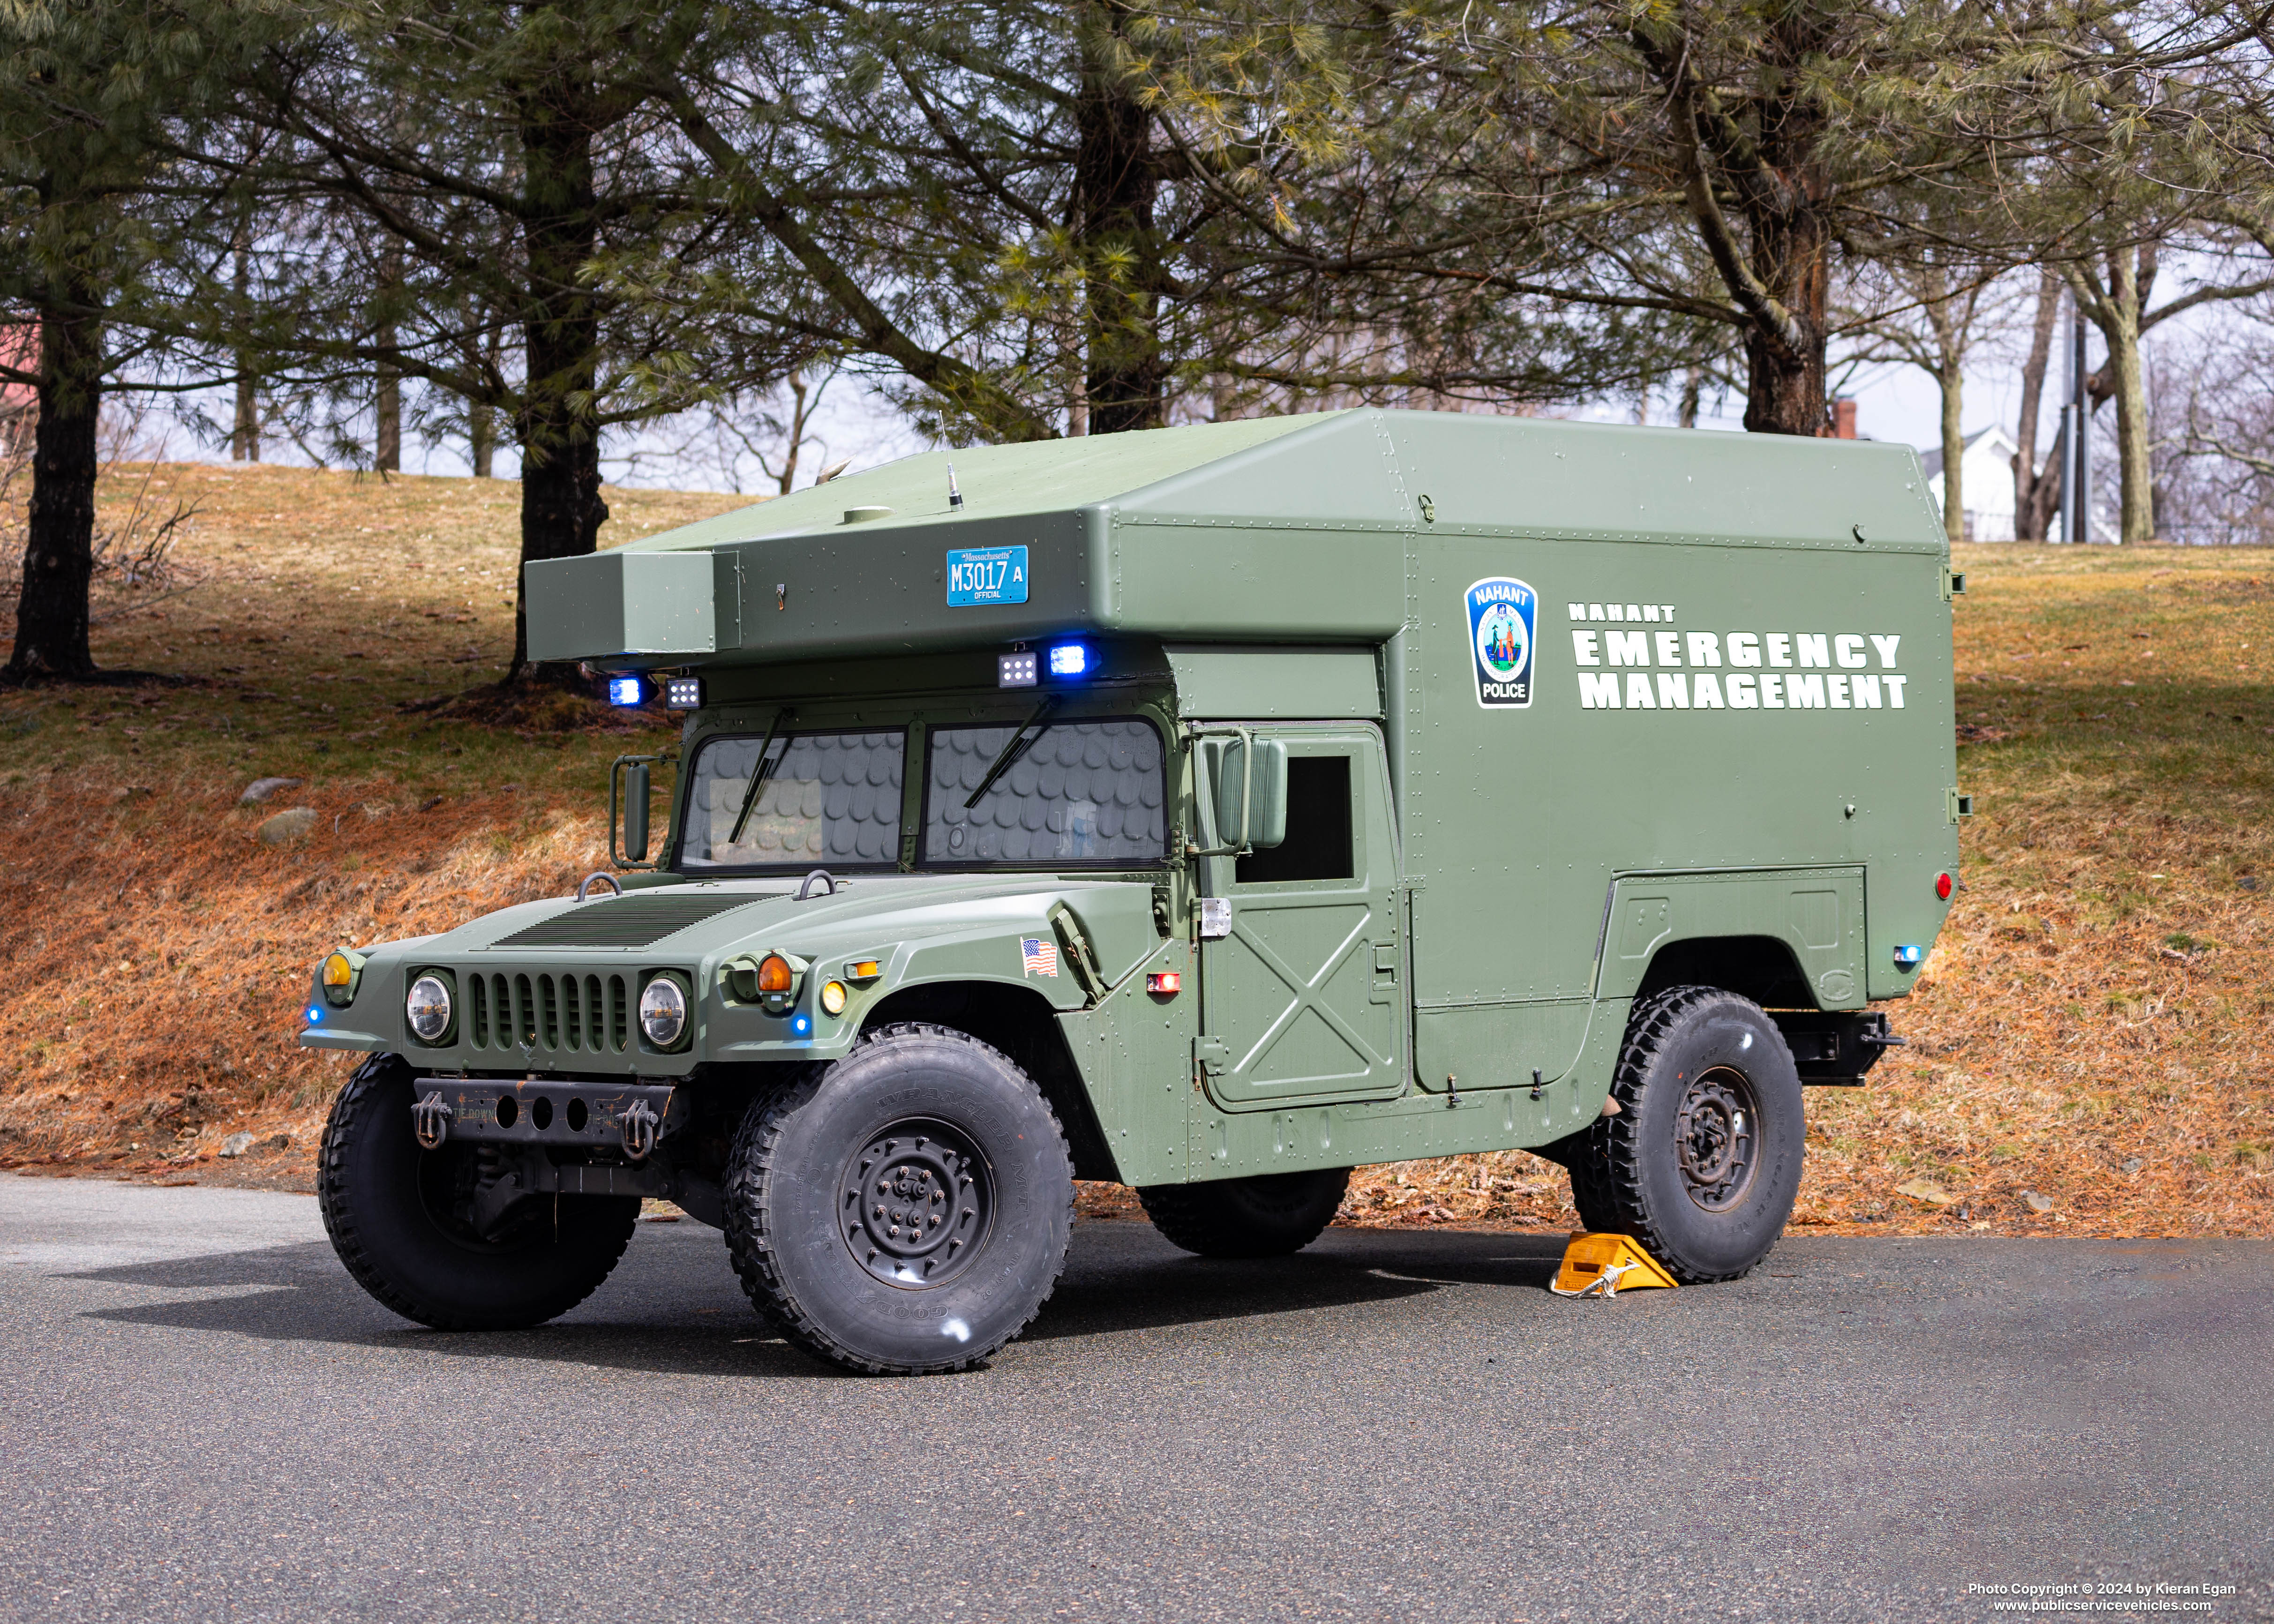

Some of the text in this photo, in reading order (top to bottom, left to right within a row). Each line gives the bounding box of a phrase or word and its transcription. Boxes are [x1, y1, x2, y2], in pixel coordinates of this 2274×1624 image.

[965, 552, 1009, 561] Massachusetts
[952, 561, 1023, 592] M3017 A
[975, 591, 1001, 599] OFFICIAL
[1475, 585, 1529, 606] NAHANT
[1568, 602, 1675, 622] NAHANT
[1571, 629, 1901, 669] EMERGENCY
[1483, 683, 1526, 698] POLICE
[1577, 672, 1907, 710] MANAGEMENT
[453, 1108, 494, 1119] TIE DOWN
[875, 1087, 1029, 1212] WRANGLER MT
